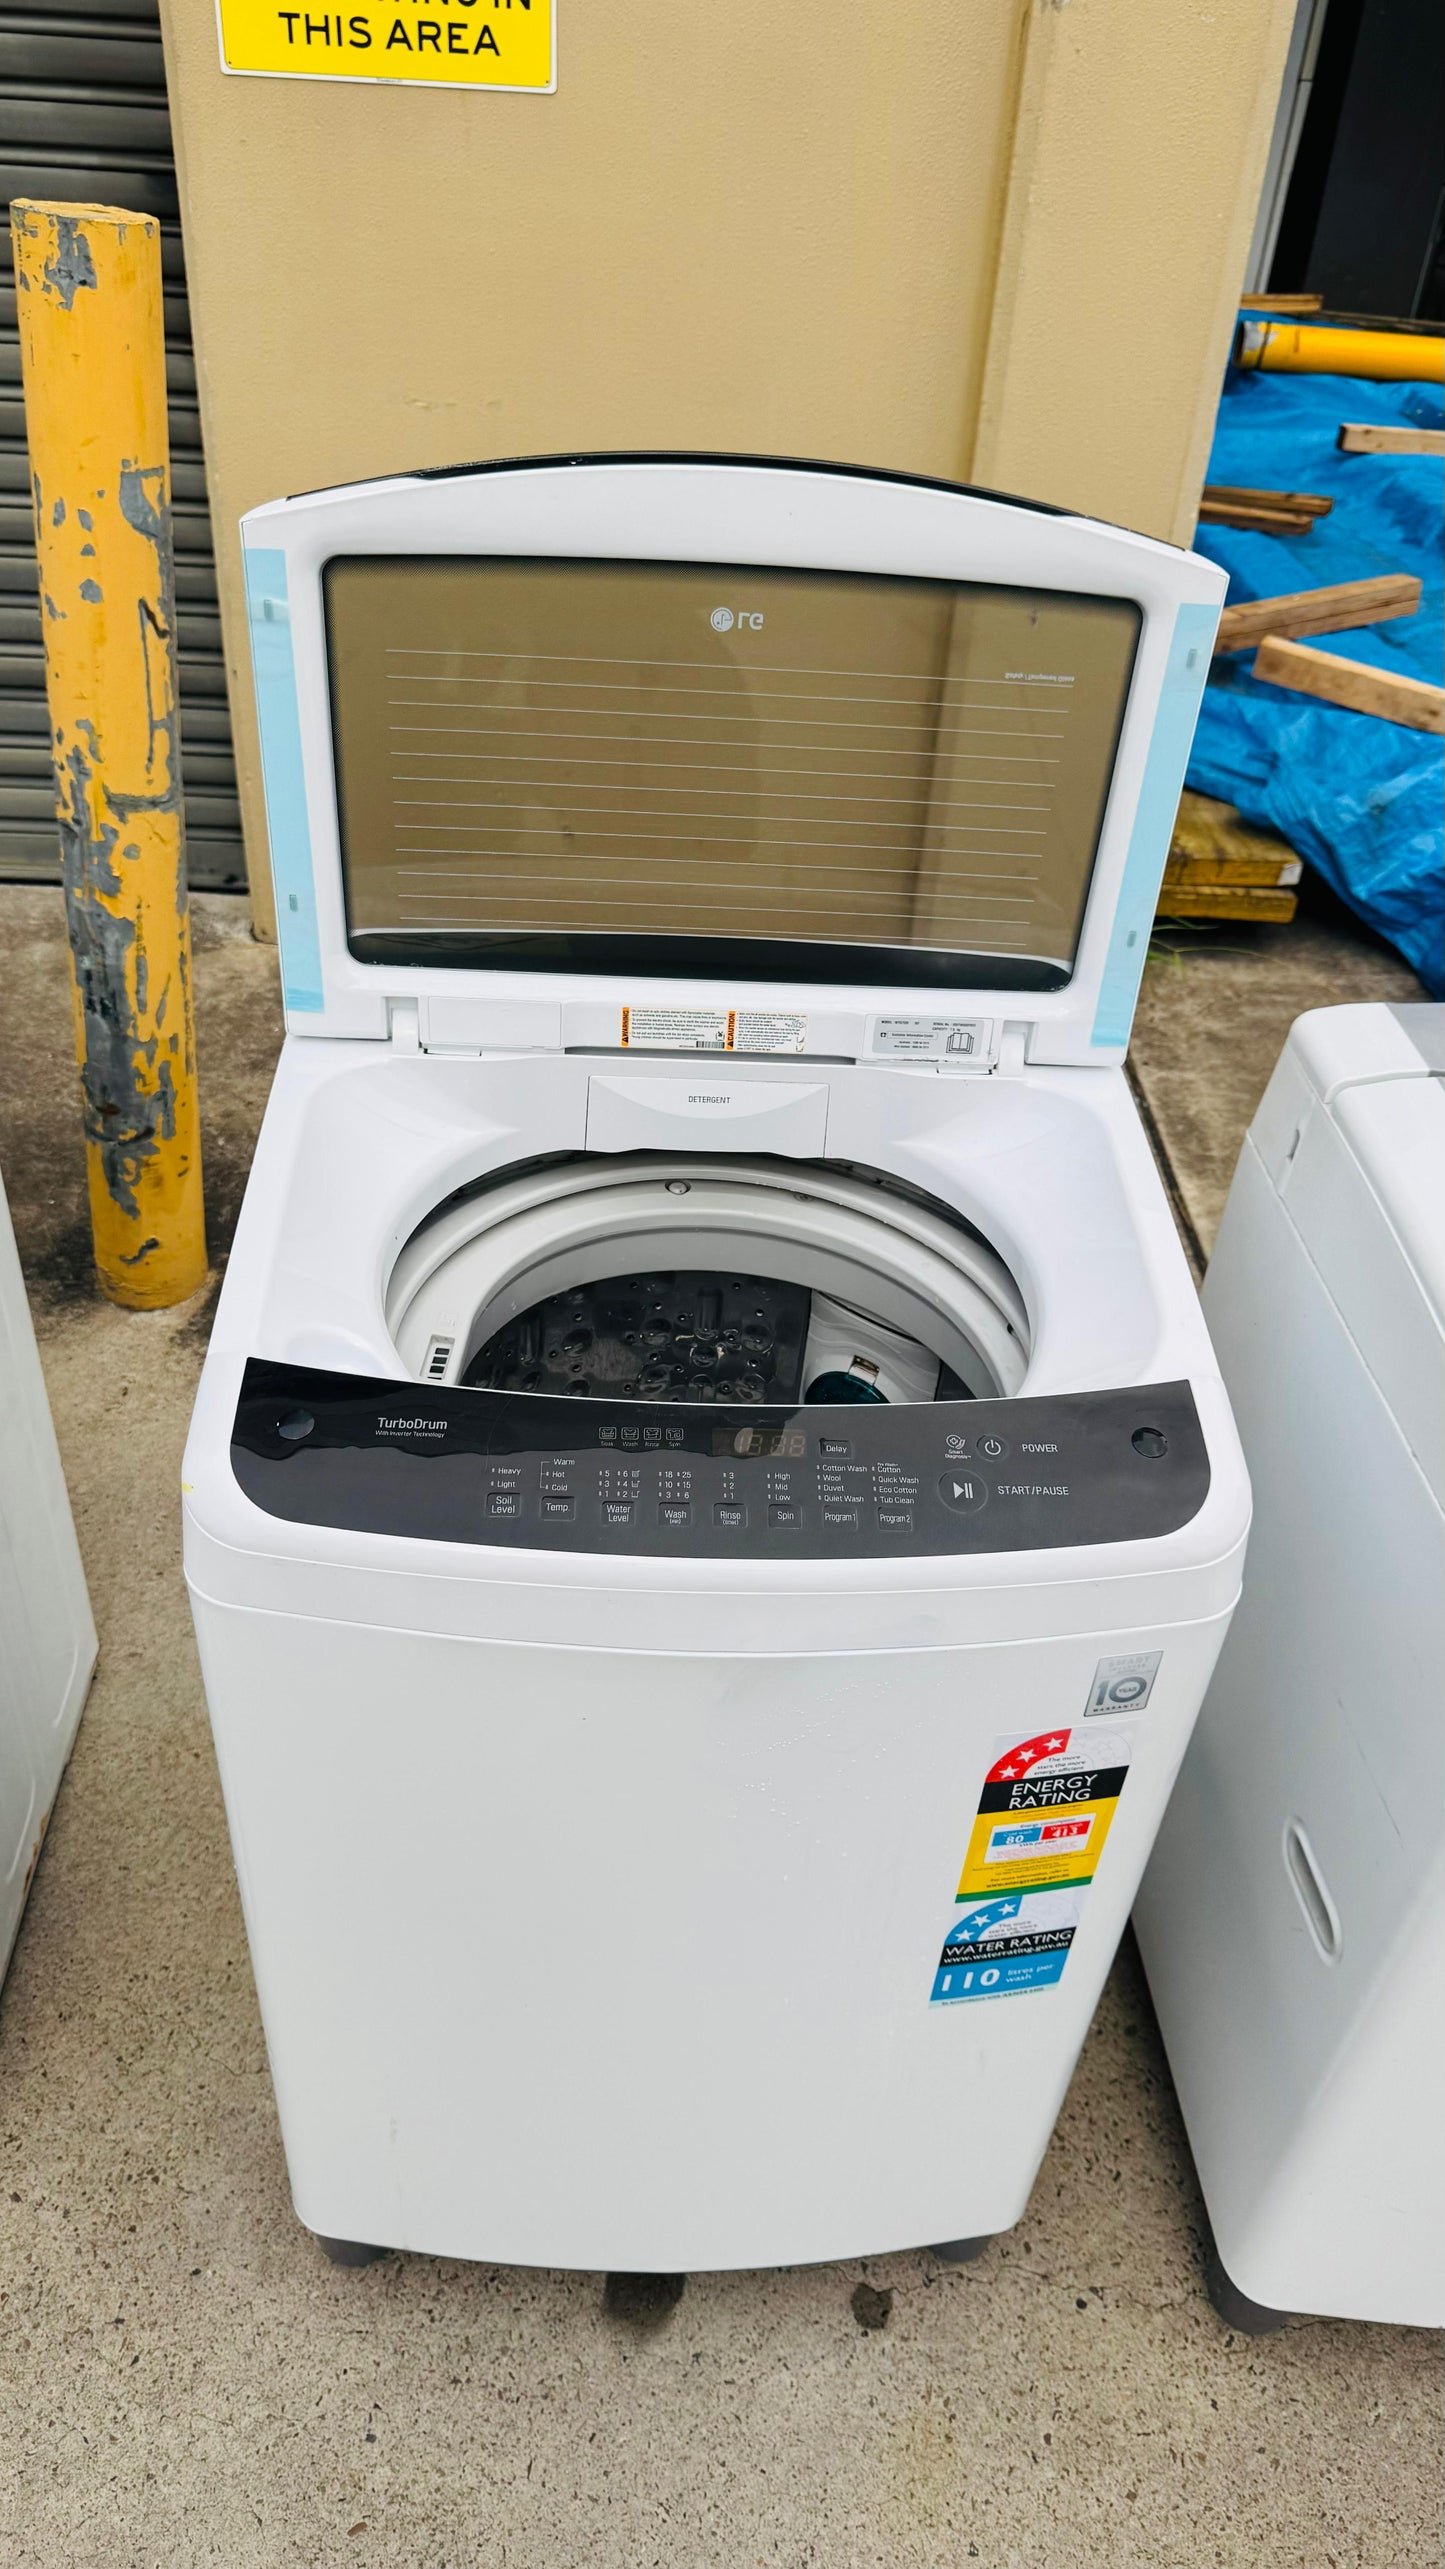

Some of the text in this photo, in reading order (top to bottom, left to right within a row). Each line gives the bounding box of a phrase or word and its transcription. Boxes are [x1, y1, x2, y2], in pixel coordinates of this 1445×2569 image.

[278, 12, 501, 57] THIS AREA
[378, 1418, 448, 1430] TurboDrum
[826, 1445, 847, 1454] Delay
[1022, 1444, 1058, 1453] POWER
[498, 1468, 522, 1476] Heavy
[822, 1464, 846, 1472] Cotton
[623, 1470, 629, 1478] 6
[774, 1472, 790, 1480] High
[878, 1476, 898, 1484] Quick
[497, 1481, 516, 1489] Light
[551, 1483, 568, 1491] Cold
[729, 1482, 735, 1490] 2
[823, 1484, 844, 1492] Duvet
[997, 1486, 1069, 1495] START/PAUSE
[496, 1496, 512, 1504] Soil
[491, 1505, 516, 1514] Level
[546, 1503, 571, 1512] Temp.
[606, 1505, 631, 1514] Water
[608, 1513, 629, 1523] Level
[664, 1510, 687, 1519] Wash
[720, 1510, 741, 1520] Rinse
[777, 1511, 794, 1521] Spin
[824, 1512, 852, 1523] Program
[879, 1514, 905, 1524] Program
[1096, 1676, 1147, 1705] 10
[1093, 1703, 1140, 1712] WARRANTY
[1012, 1774, 1098, 1796] ENERGY
[1008, 1788, 1091, 1809] RATING
[1052, 1827, 1078, 1837] 413
[1006, 1835, 1024, 1844] 80
[946, 1930, 1072, 1956] WATER RATING
[945, 1941, 1069, 1964] www.waterrating.gov.au
[1008, 1964, 1054, 1976] litres per
[941, 1968, 1000, 1992] 110
[1006, 1973, 1031, 1982] wash
